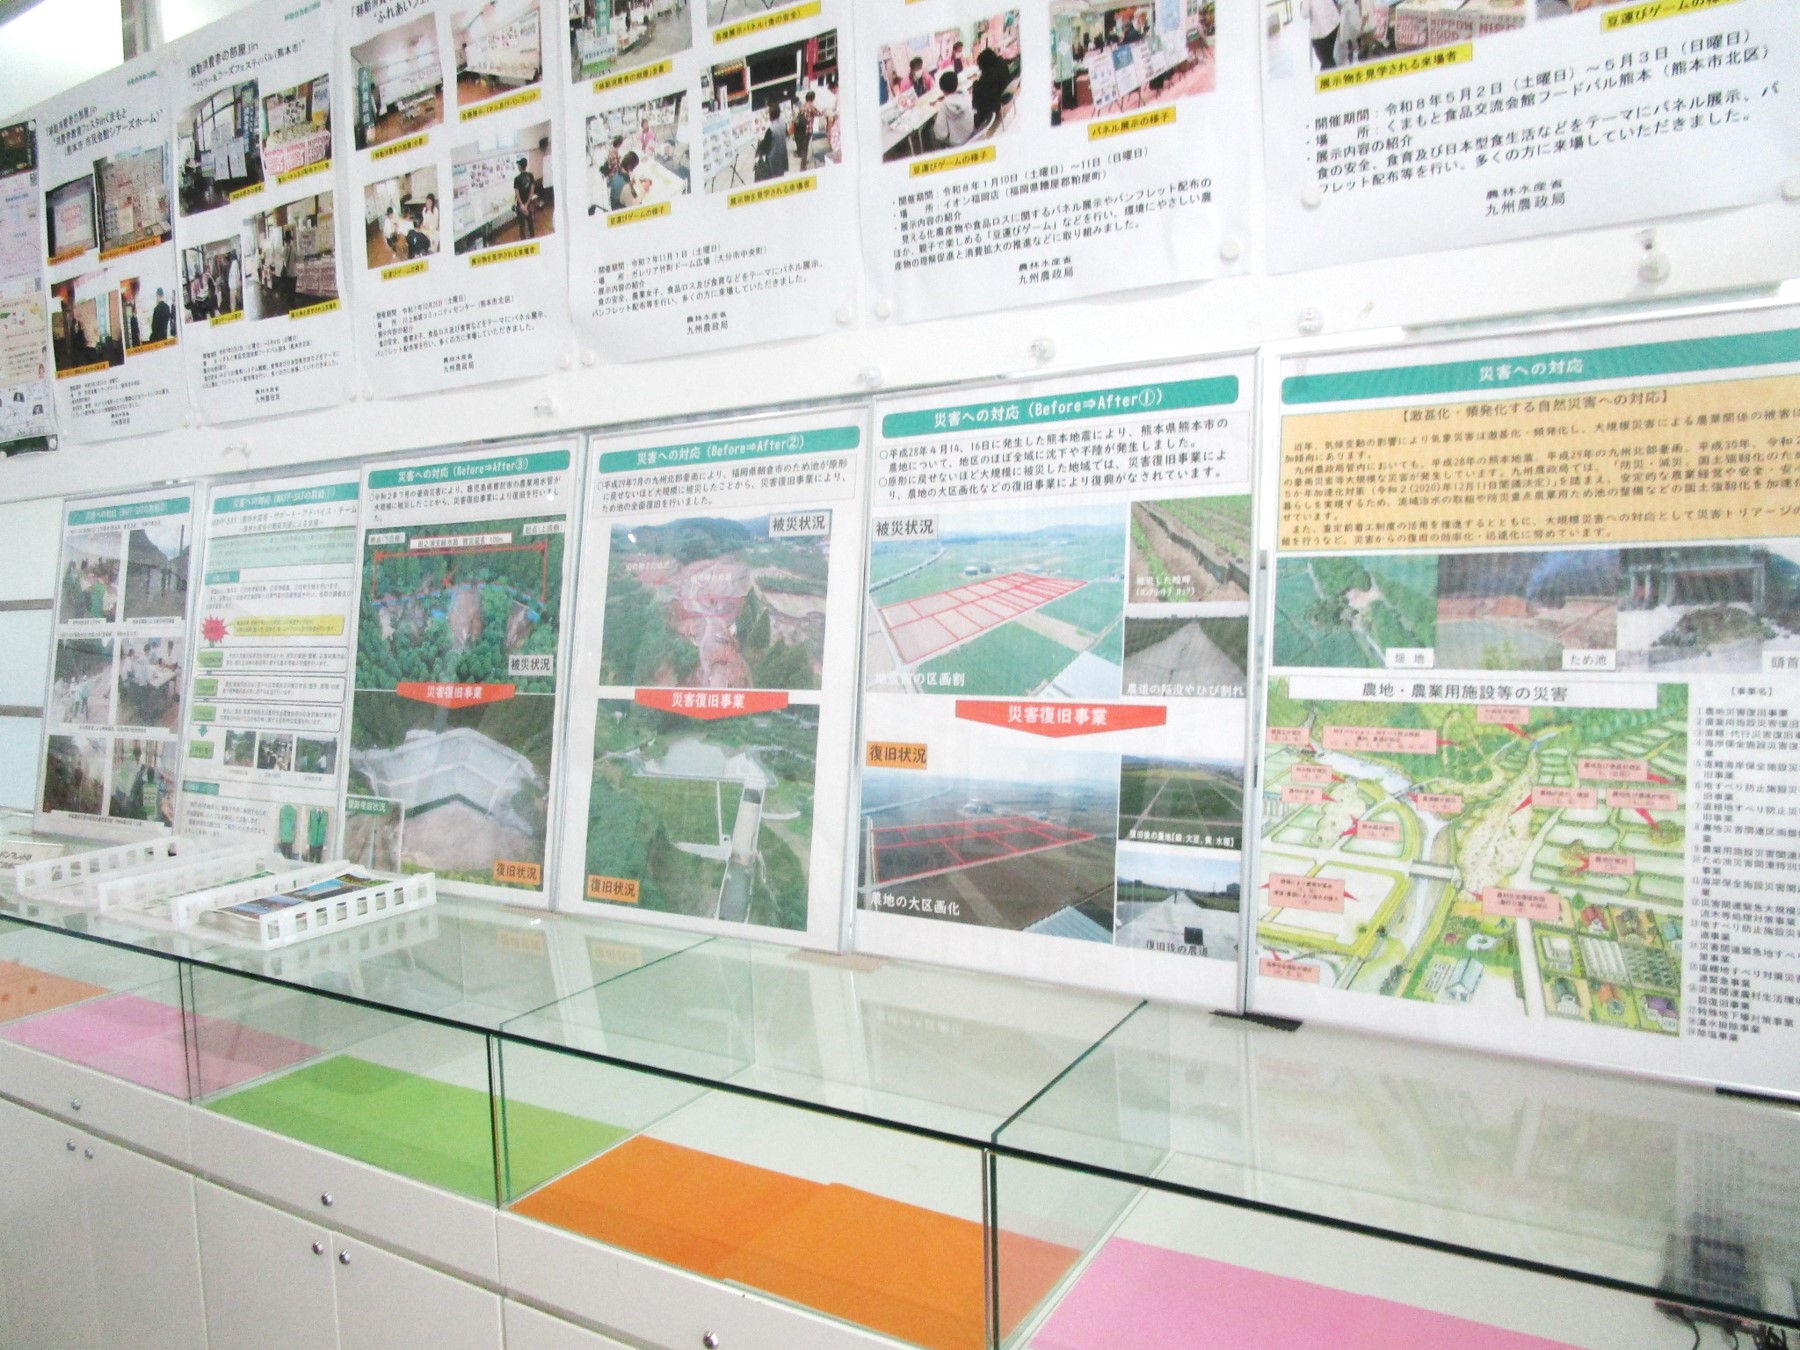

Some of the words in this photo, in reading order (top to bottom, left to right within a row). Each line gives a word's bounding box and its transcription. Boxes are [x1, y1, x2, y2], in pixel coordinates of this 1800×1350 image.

[1485, 193, 1566, 216] 九州農政局
[1018, 267, 1074, 285] 九州農政局
[1479, 358, 1583, 382] 災害への対応
[772, 515, 826, 531] 被災状況
[875, 518, 934, 537] 被災状況
[511, 658, 551, 672] 被災状況
[1570, 654, 1607, 667] ため池
[427, 684, 483, 700] 災害復旧事業
[1127, 683, 1244, 697] 農道の陥没やひび割れ
[1363, 682, 1568, 702] 農地・農業用施設等の災害
[672, 692, 745, 709] 災害復旧事業
[1008, 705, 1108, 726] 災害復旧事業
[870, 745, 927, 764] 復旧状況
[496, 861, 538, 879] 復旧状況
[591, 878, 636, 897] 復旧状況
[871, 891, 961, 917] 農地の大区画化
